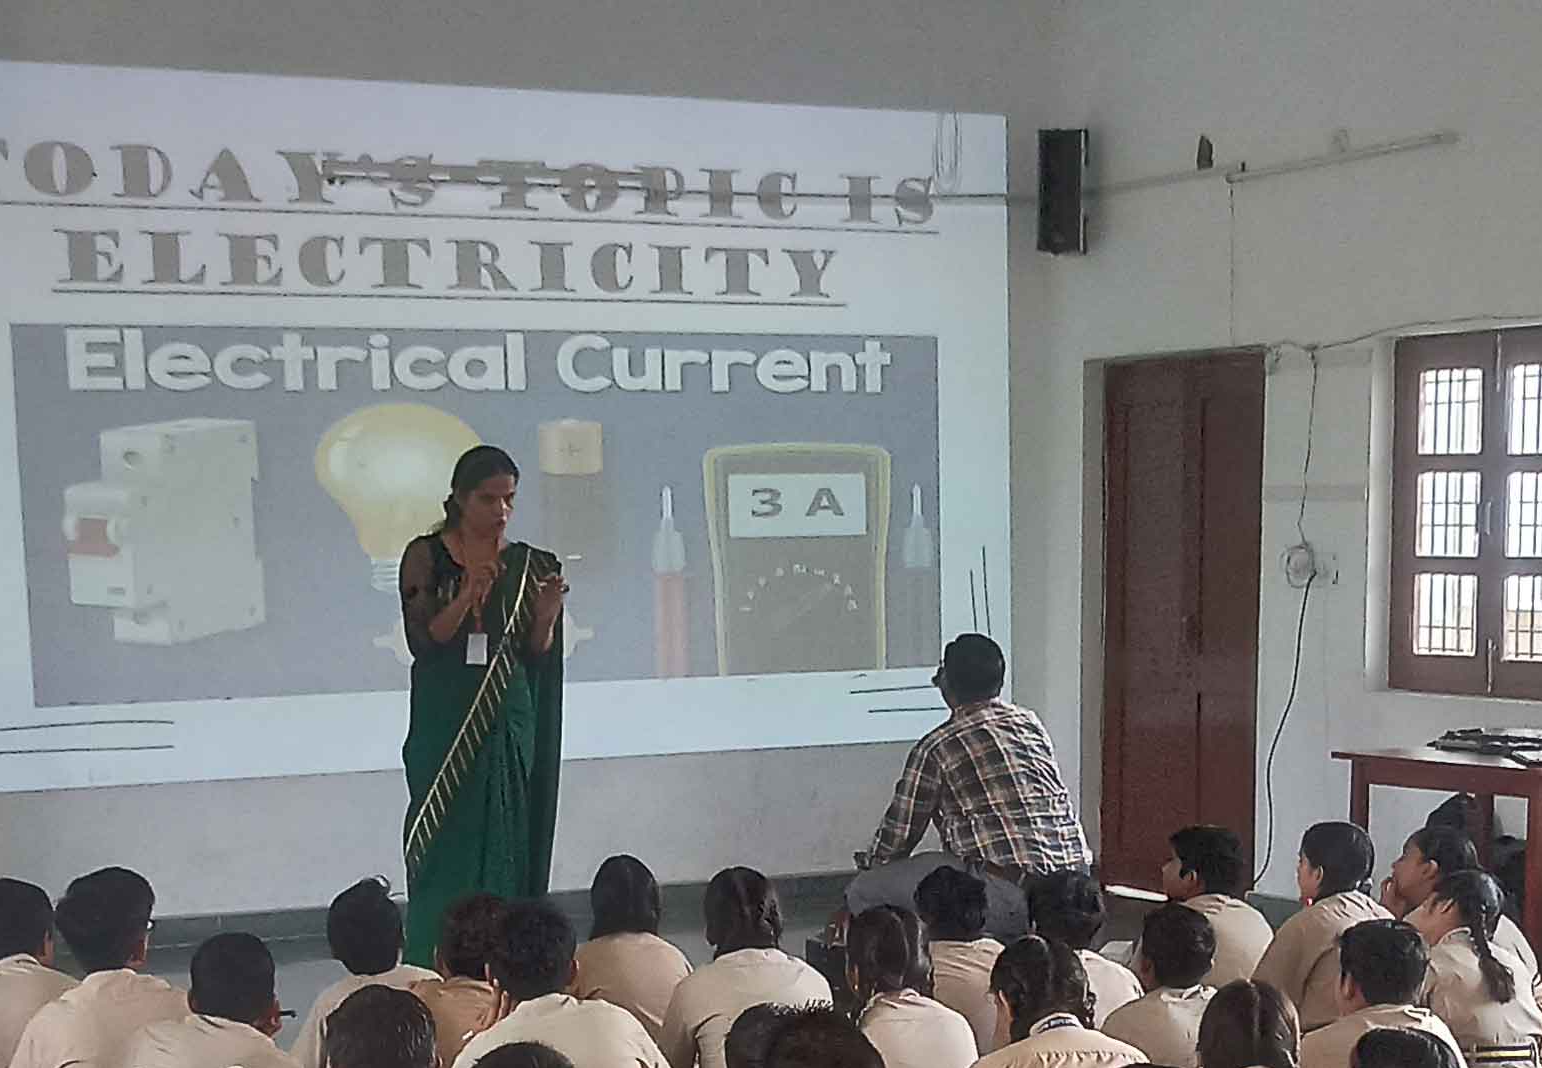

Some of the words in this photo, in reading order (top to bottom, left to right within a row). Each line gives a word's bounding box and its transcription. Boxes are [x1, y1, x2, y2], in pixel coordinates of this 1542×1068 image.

[476, 158, 798, 221] TOPIC
[840, 172, 935, 226] IS
[53, 228, 836, 298] ELECTRICITY
[64, 327, 528, 392] Electrical
[556, 334, 892, 394] Current
[751, 487, 783, 518] 3
[805, 487, 845, 517] A
